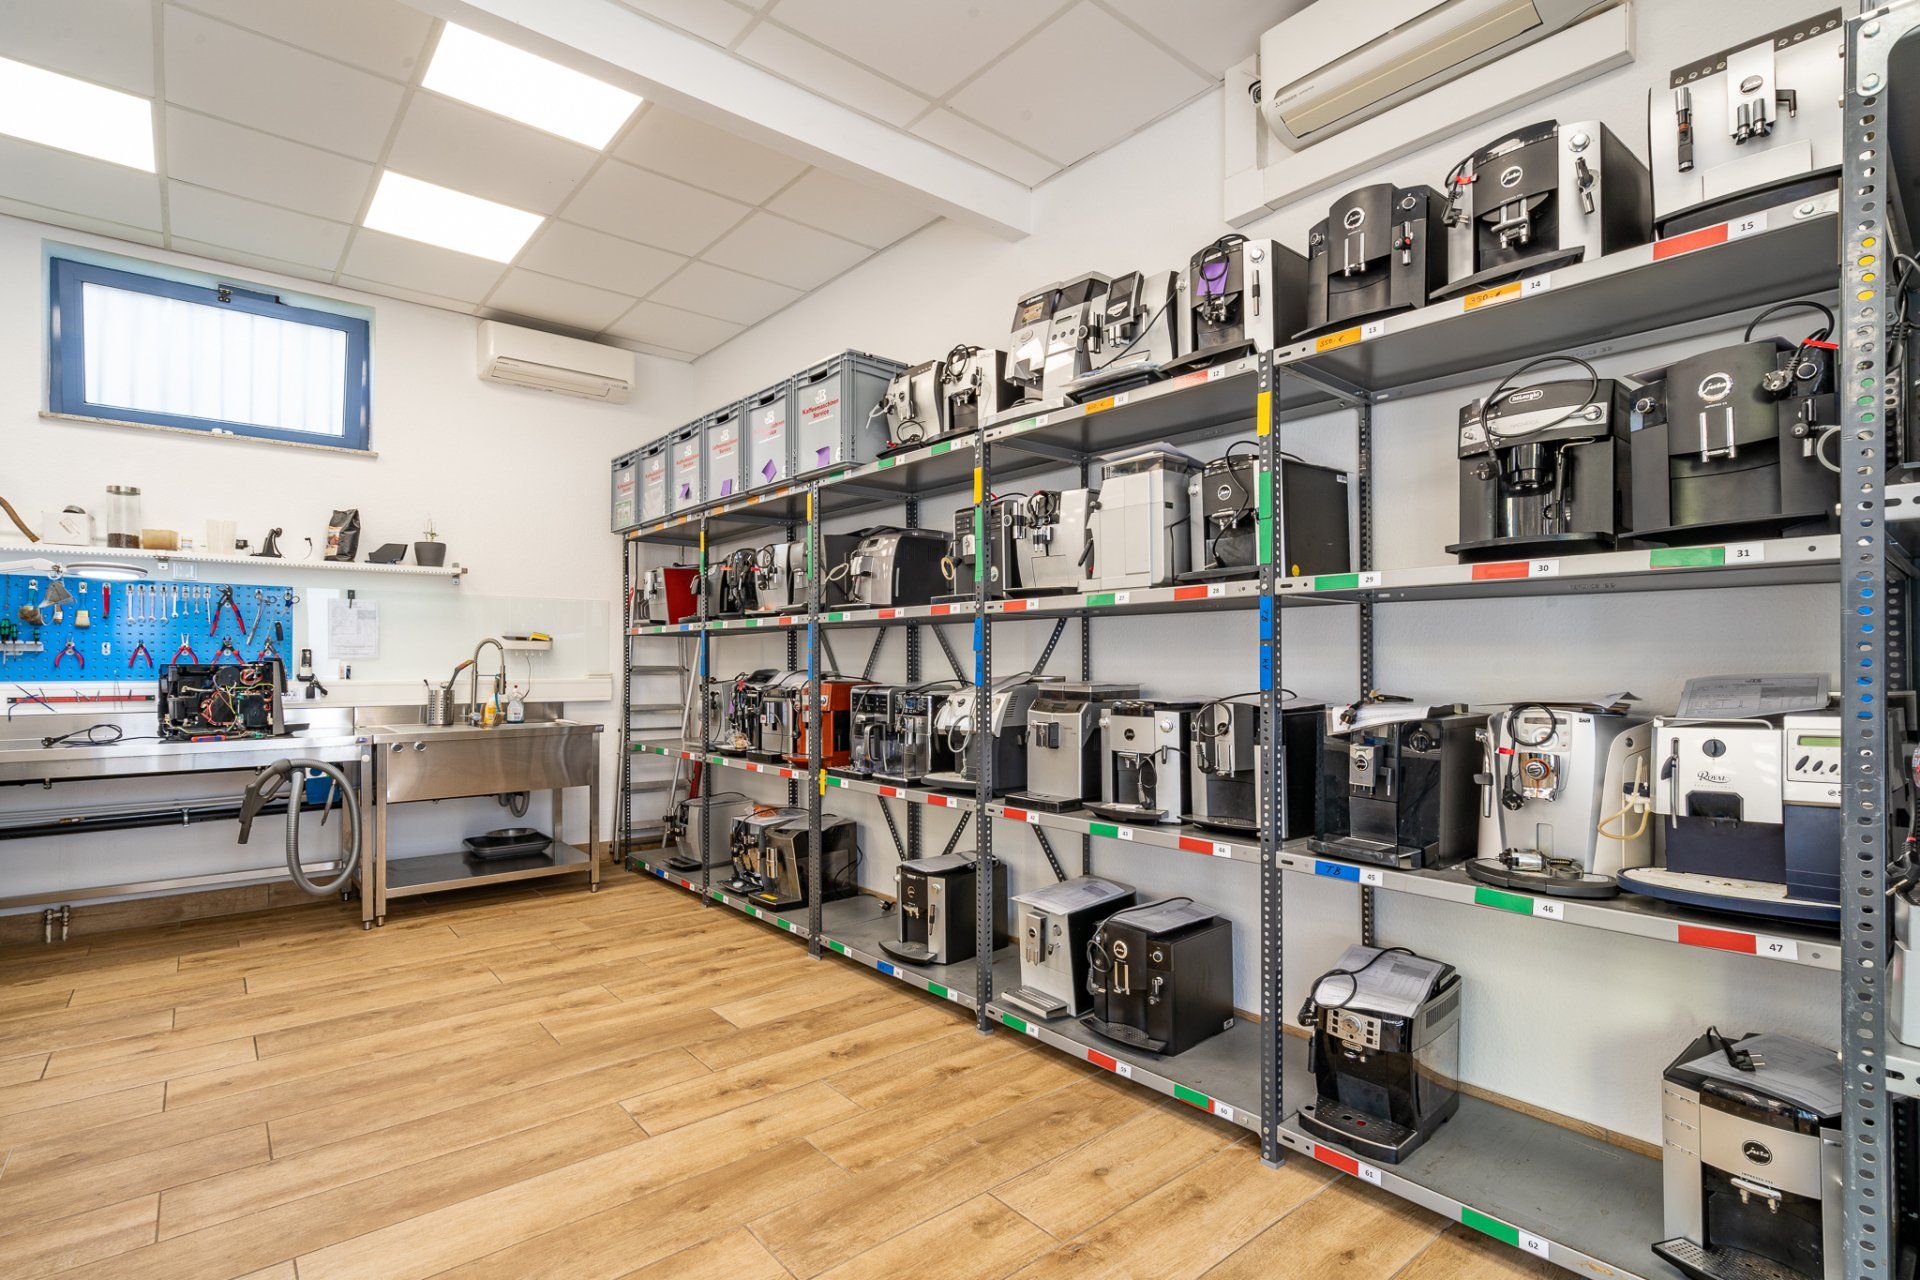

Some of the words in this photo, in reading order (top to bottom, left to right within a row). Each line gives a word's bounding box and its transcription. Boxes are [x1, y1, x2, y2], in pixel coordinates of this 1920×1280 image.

[1741, 221, 1754, 231] 15
[1531, 281, 1541, 290] 14
[1368, 326, 1377, 334] 13
[1737, 549, 1750, 558] 31
[1538, 564, 1549, 572] 30
[1365, 576, 1374, 584] 29
[1543, 905, 1554, 913] 46
[1769, 943, 1783, 953] 47
[1365, 1169, 1374, 1178] 61
[1528, 1240, 1539, 1250] 62
